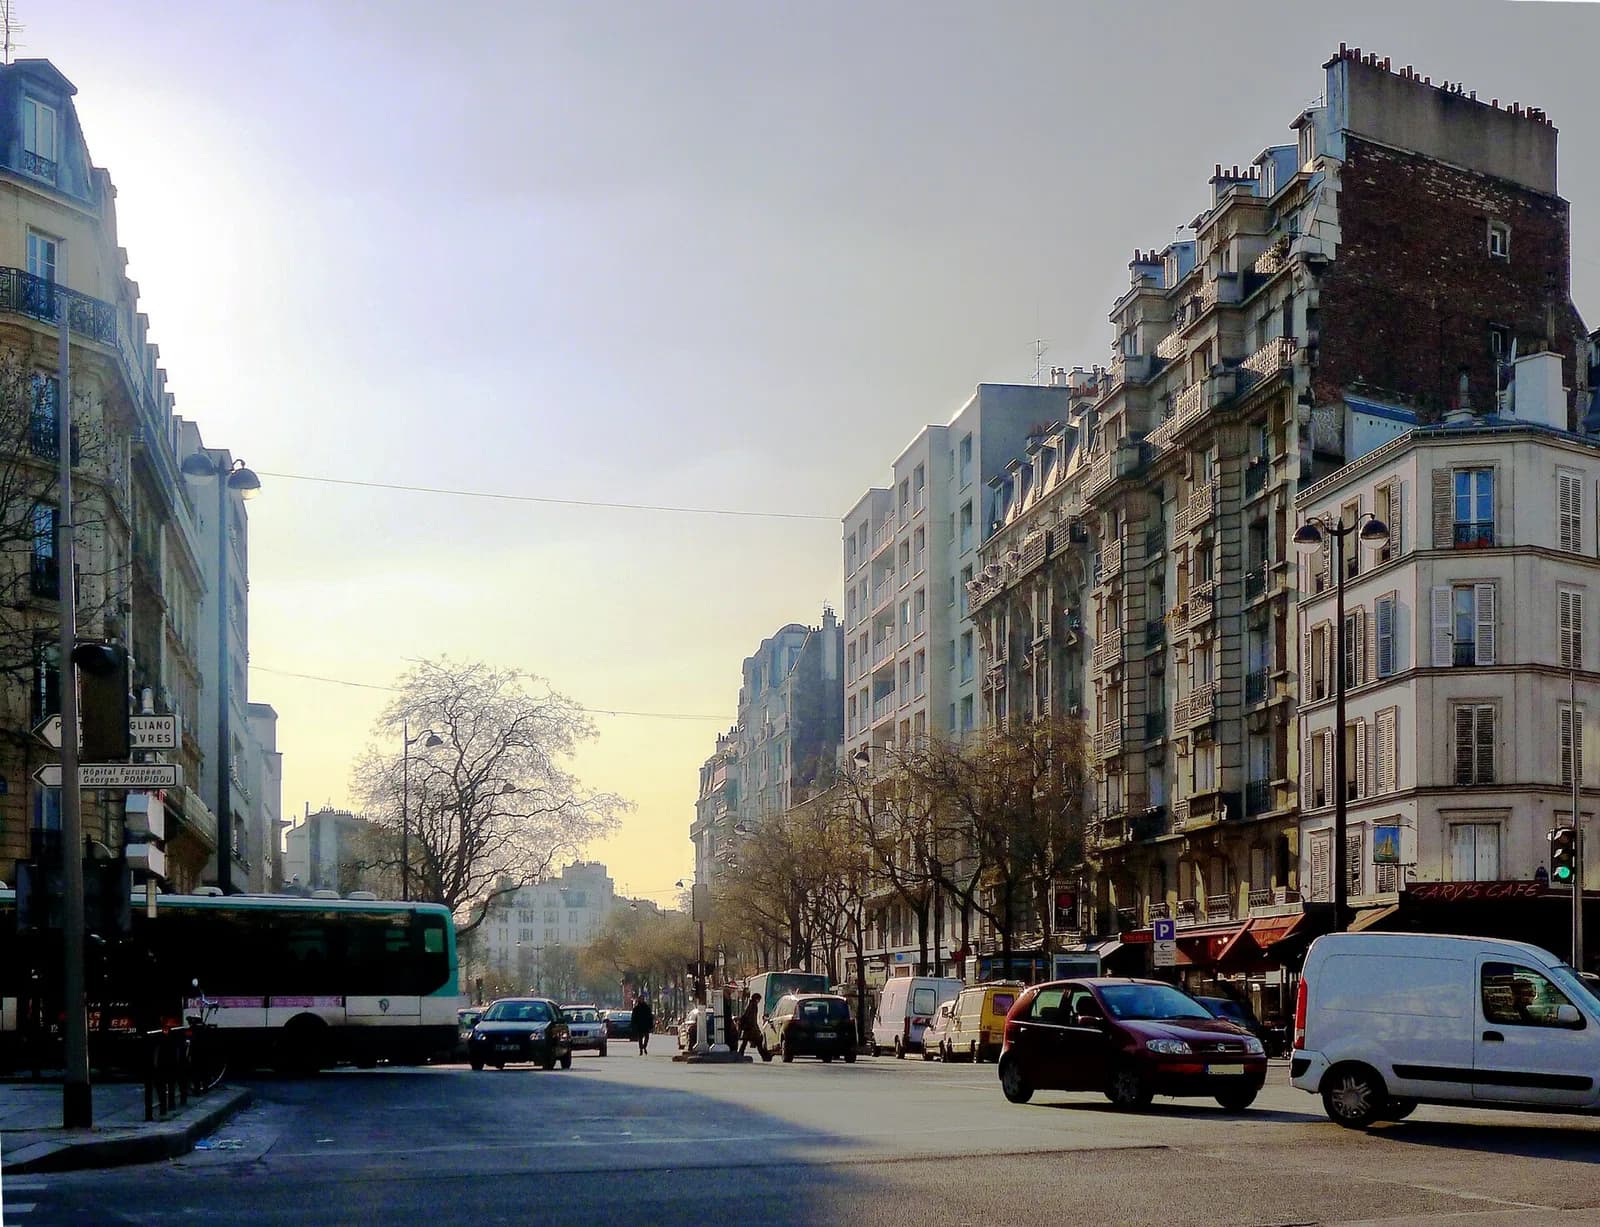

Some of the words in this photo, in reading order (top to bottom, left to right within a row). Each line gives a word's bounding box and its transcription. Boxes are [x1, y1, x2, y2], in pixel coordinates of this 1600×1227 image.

[83, 767, 116, 776] Hôpital
[83, 775, 119, 784] Georges
[123, 776, 172, 784] POMPIDOU
[1160, 924, 1169, 938] P
